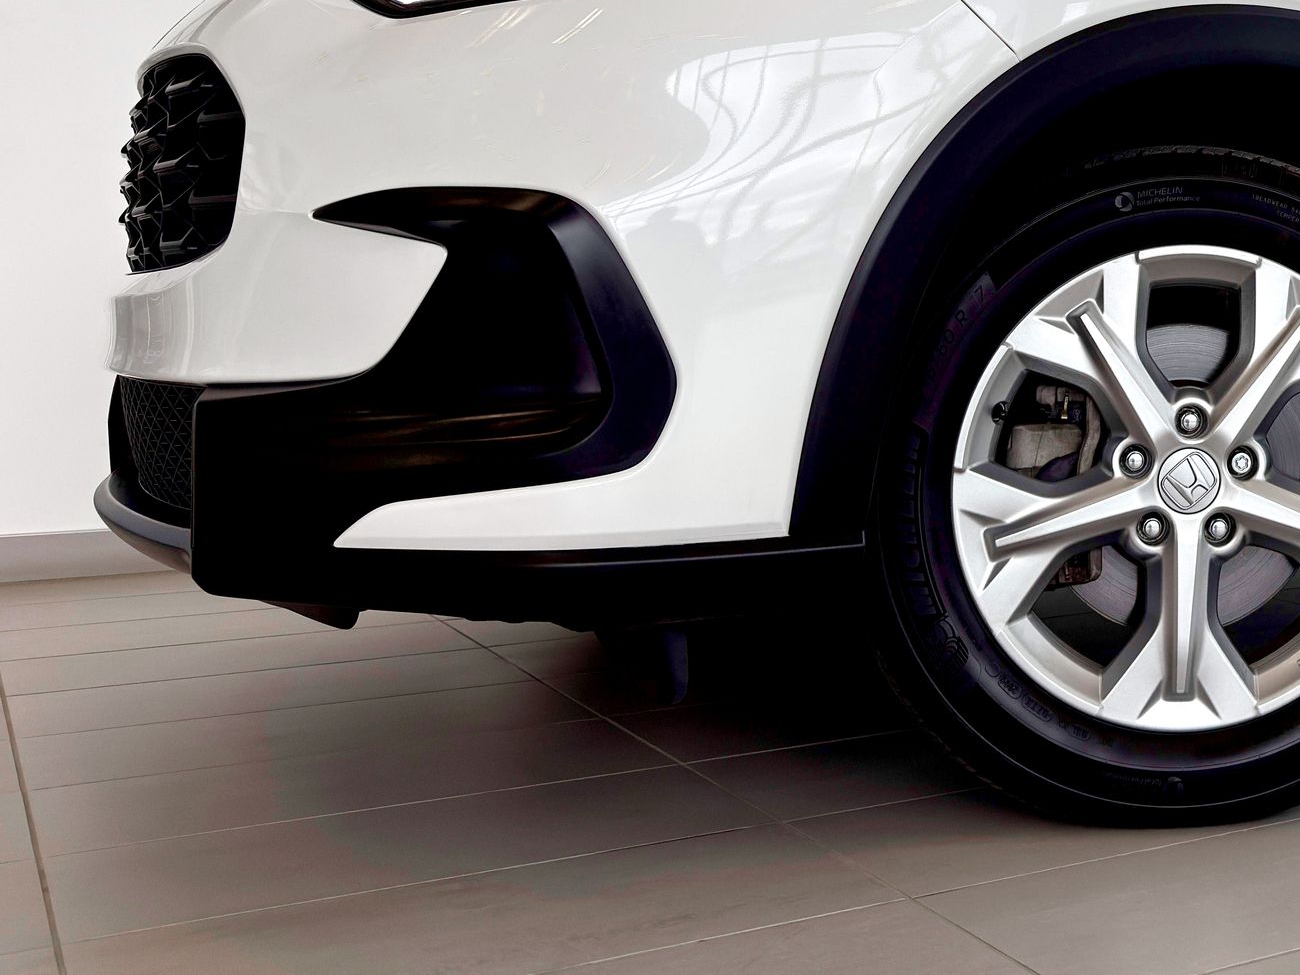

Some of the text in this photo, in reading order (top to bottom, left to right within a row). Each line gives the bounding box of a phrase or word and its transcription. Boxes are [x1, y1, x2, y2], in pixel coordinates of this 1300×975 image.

[1137, 186, 1184, 199] MICHELIN
[1136, 195, 1201, 207] Total Performance
